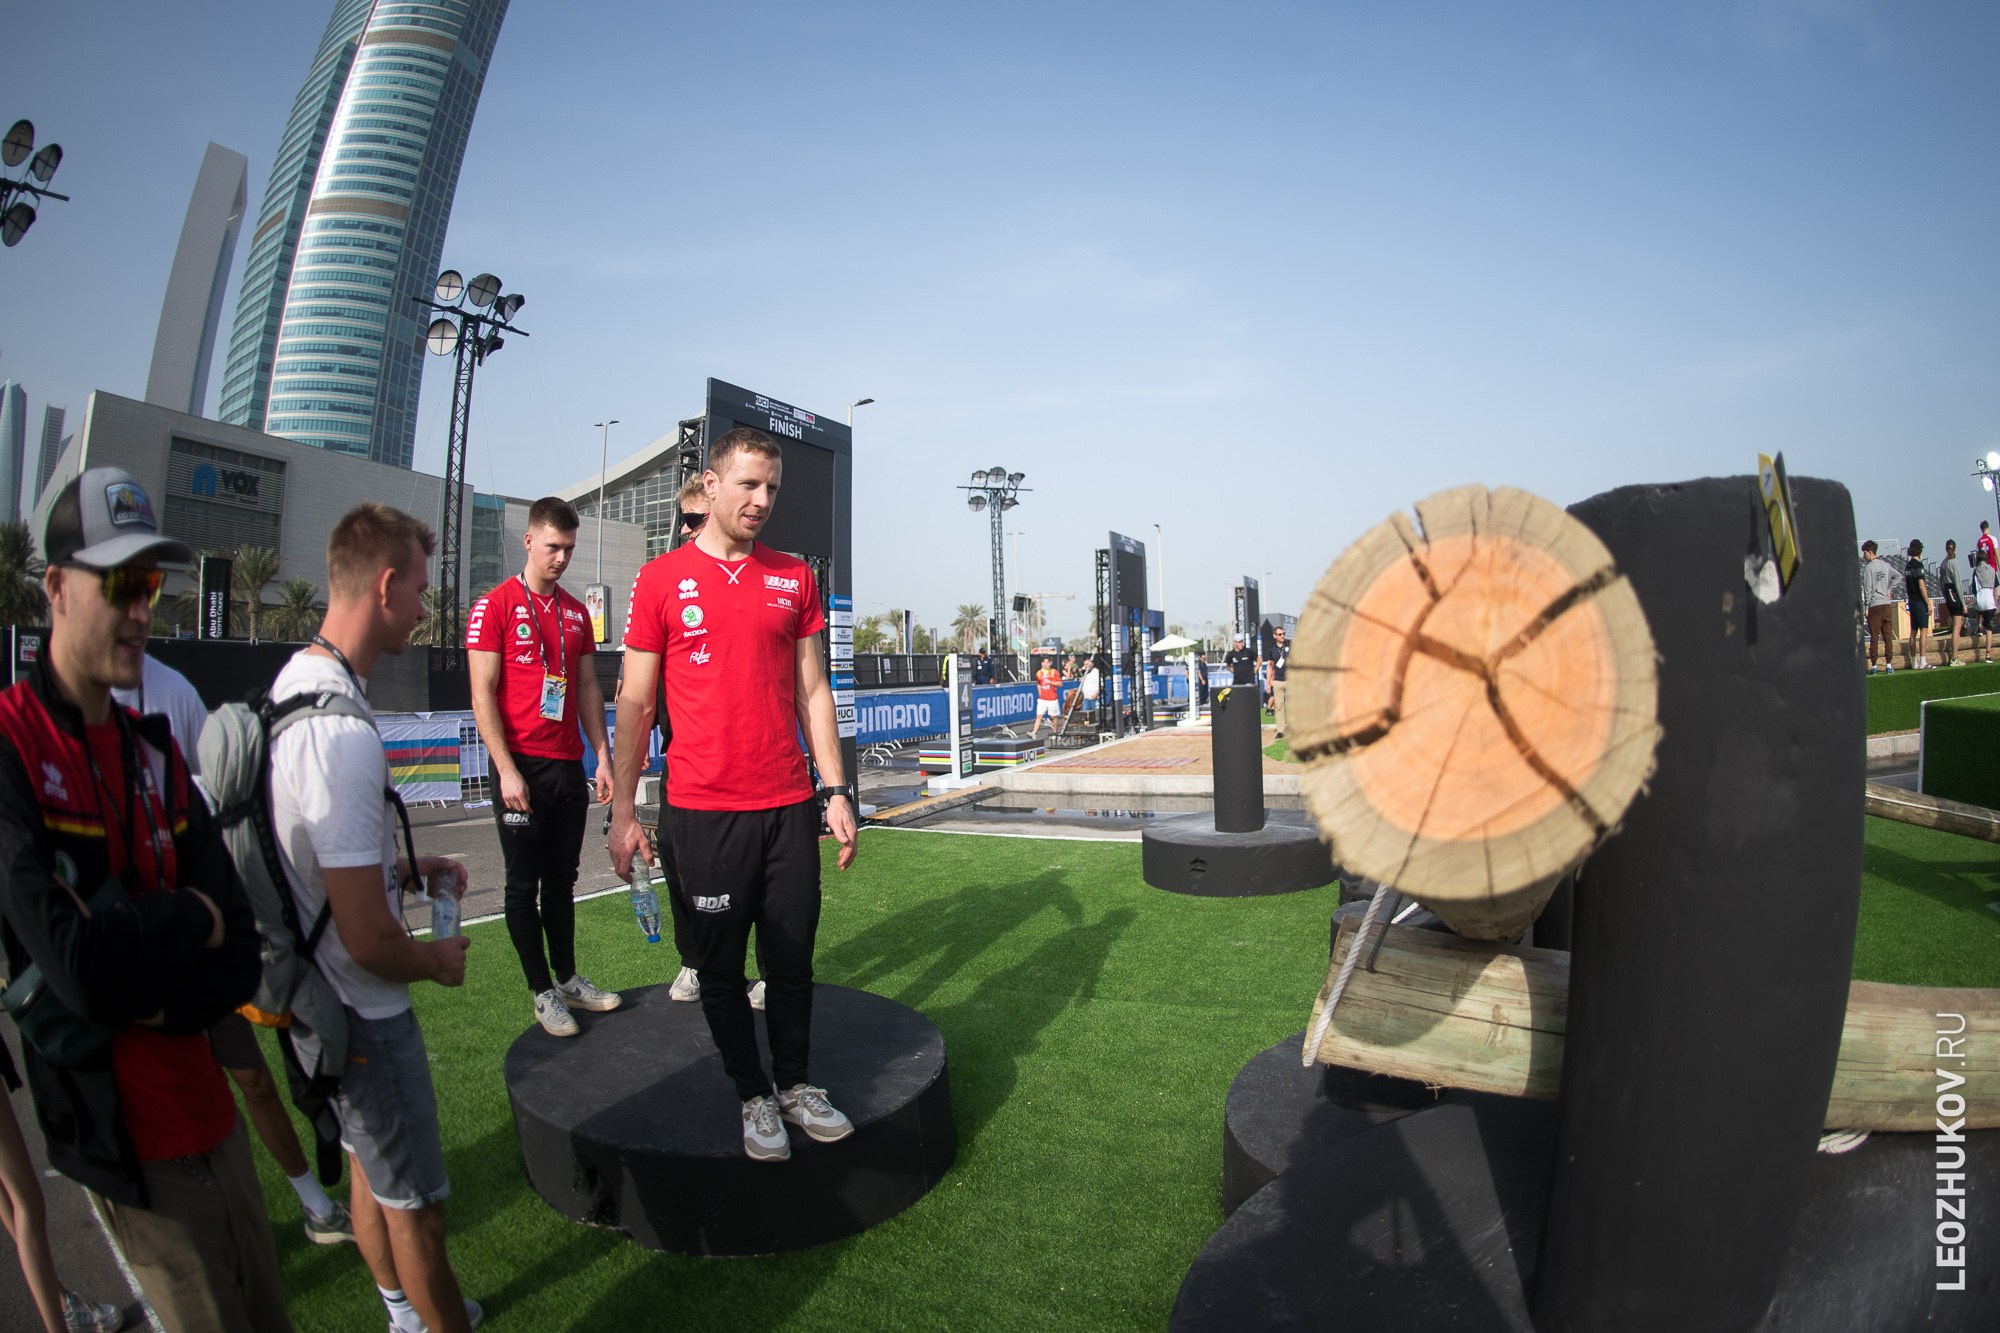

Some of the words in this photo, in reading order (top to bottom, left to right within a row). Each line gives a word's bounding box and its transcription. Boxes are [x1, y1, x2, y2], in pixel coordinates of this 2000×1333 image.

[769, 417, 802, 439] FINISH
[220, 469, 260, 497] VOX
[767, 575, 799, 591] BDR
[209, 591, 217, 617] Dhabi
[209, 619, 217, 638] Abu
[23, 638, 39, 647] UCI
[958, 673, 971, 683] START
[961, 684, 969, 707] 4
[841, 708, 854, 719] UCI
[977, 692, 1034, 719] SHIMANO
[856, 703, 931, 733] HIMANO
[1024, 750, 1035, 762] UCI
[505, 813, 530, 823] BDR
[698, 894, 730, 909] BDR
